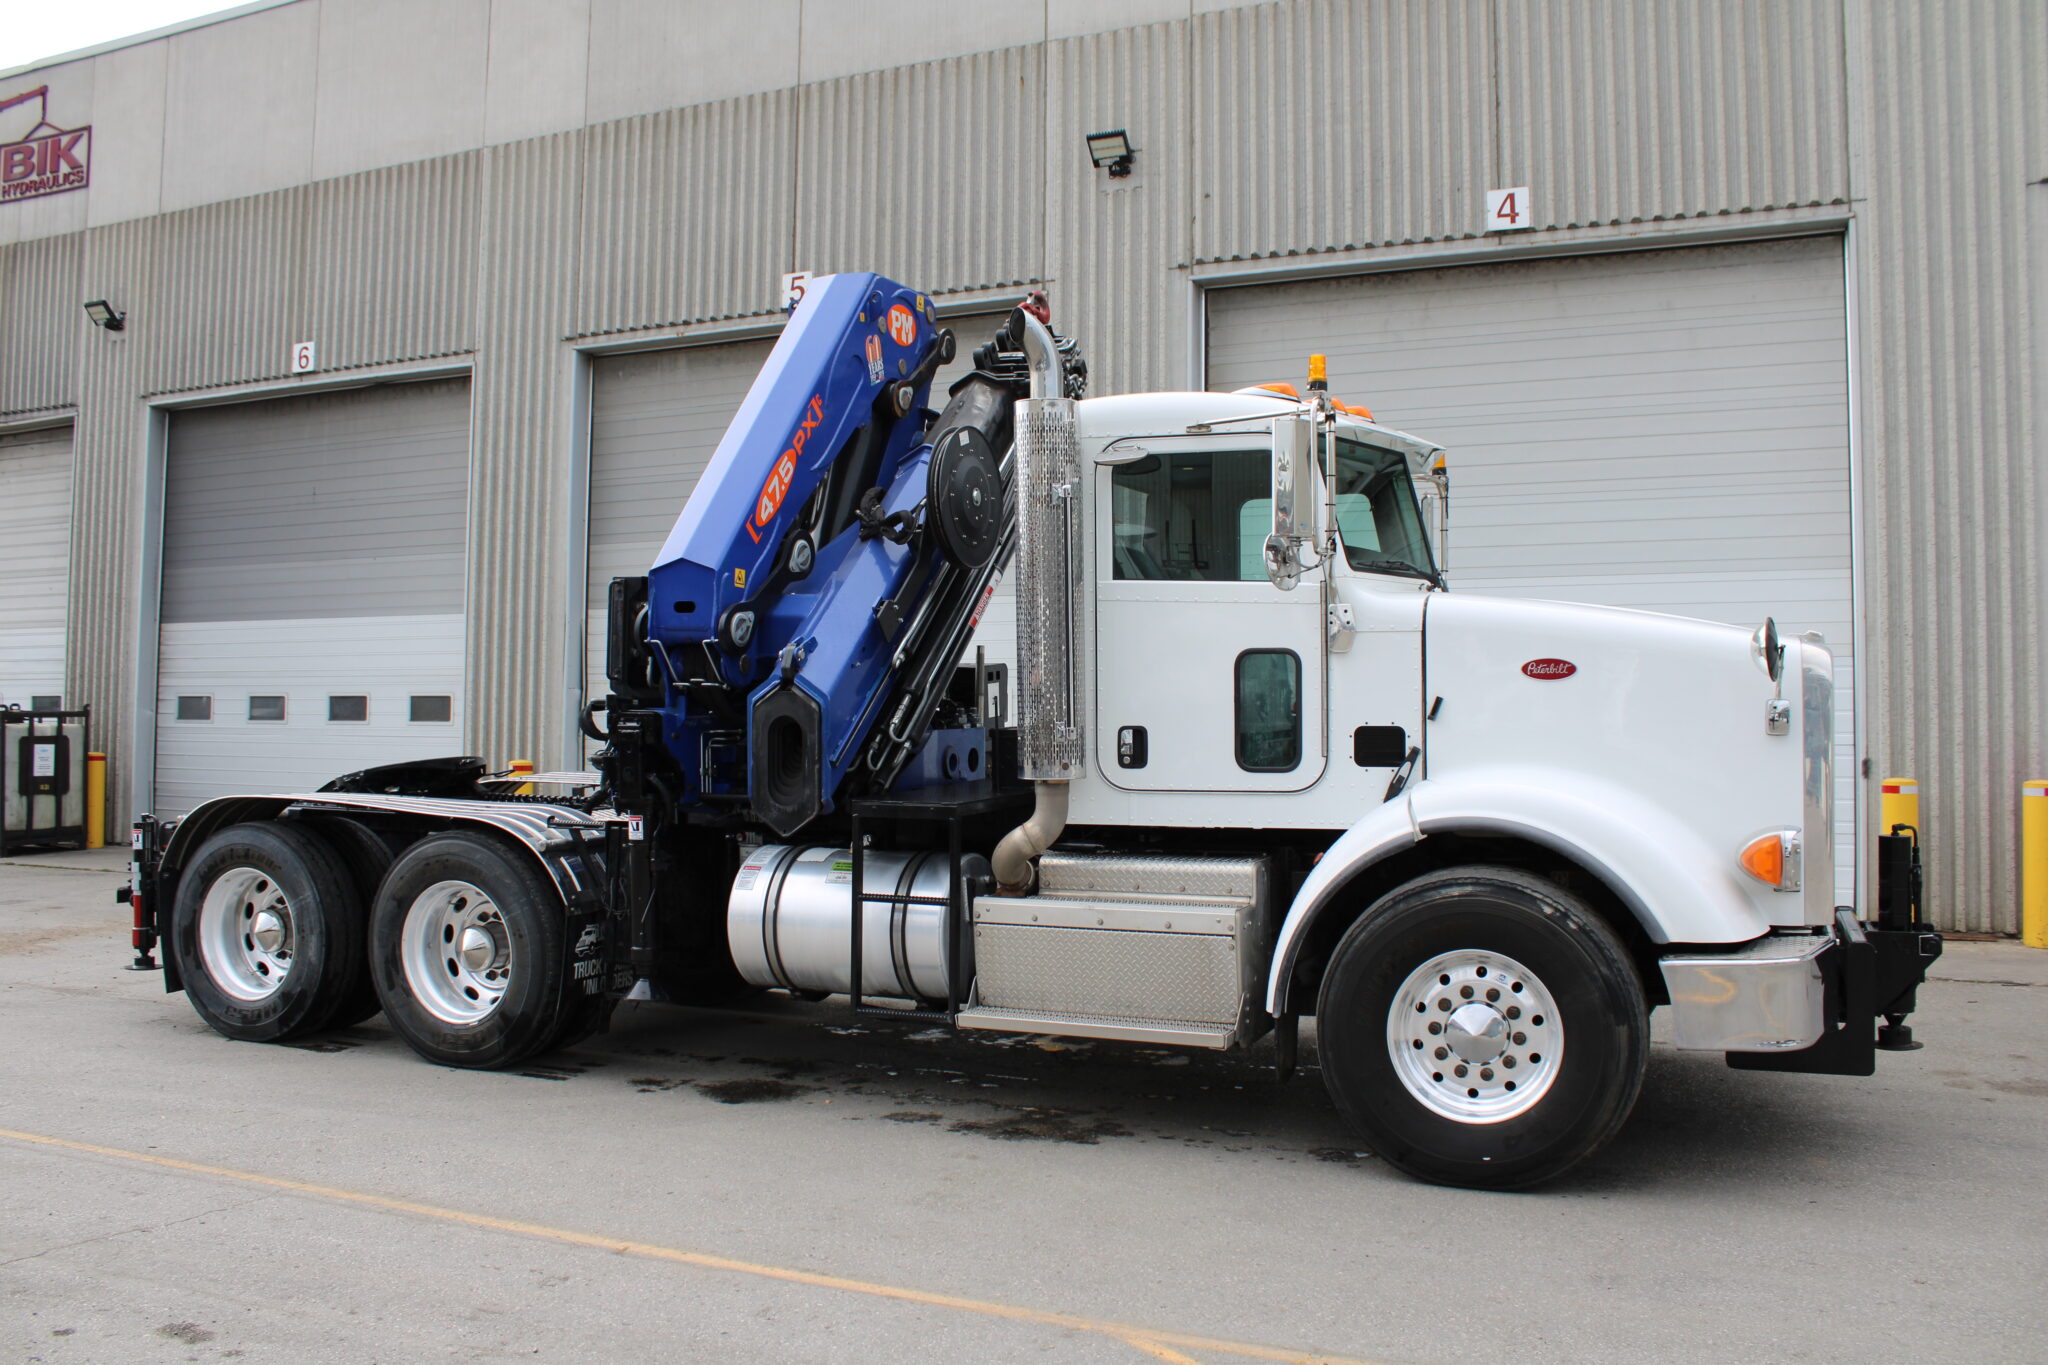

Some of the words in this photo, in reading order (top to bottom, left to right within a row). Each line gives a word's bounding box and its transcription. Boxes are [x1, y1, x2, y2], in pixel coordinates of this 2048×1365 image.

[3, 133, 84, 183] BIK
[2, 170, 84, 199] HYDRAULICS
[1497, 192, 1520, 224] 4
[790, 275, 805, 305] 5
[891, 309, 913, 345] PM
[298, 346, 310, 369] 6
[760, 455, 794, 522] 47.5
[1527, 662, 1572, 675] Peterbilt
[573, 959, 602, 980] TRUCK
